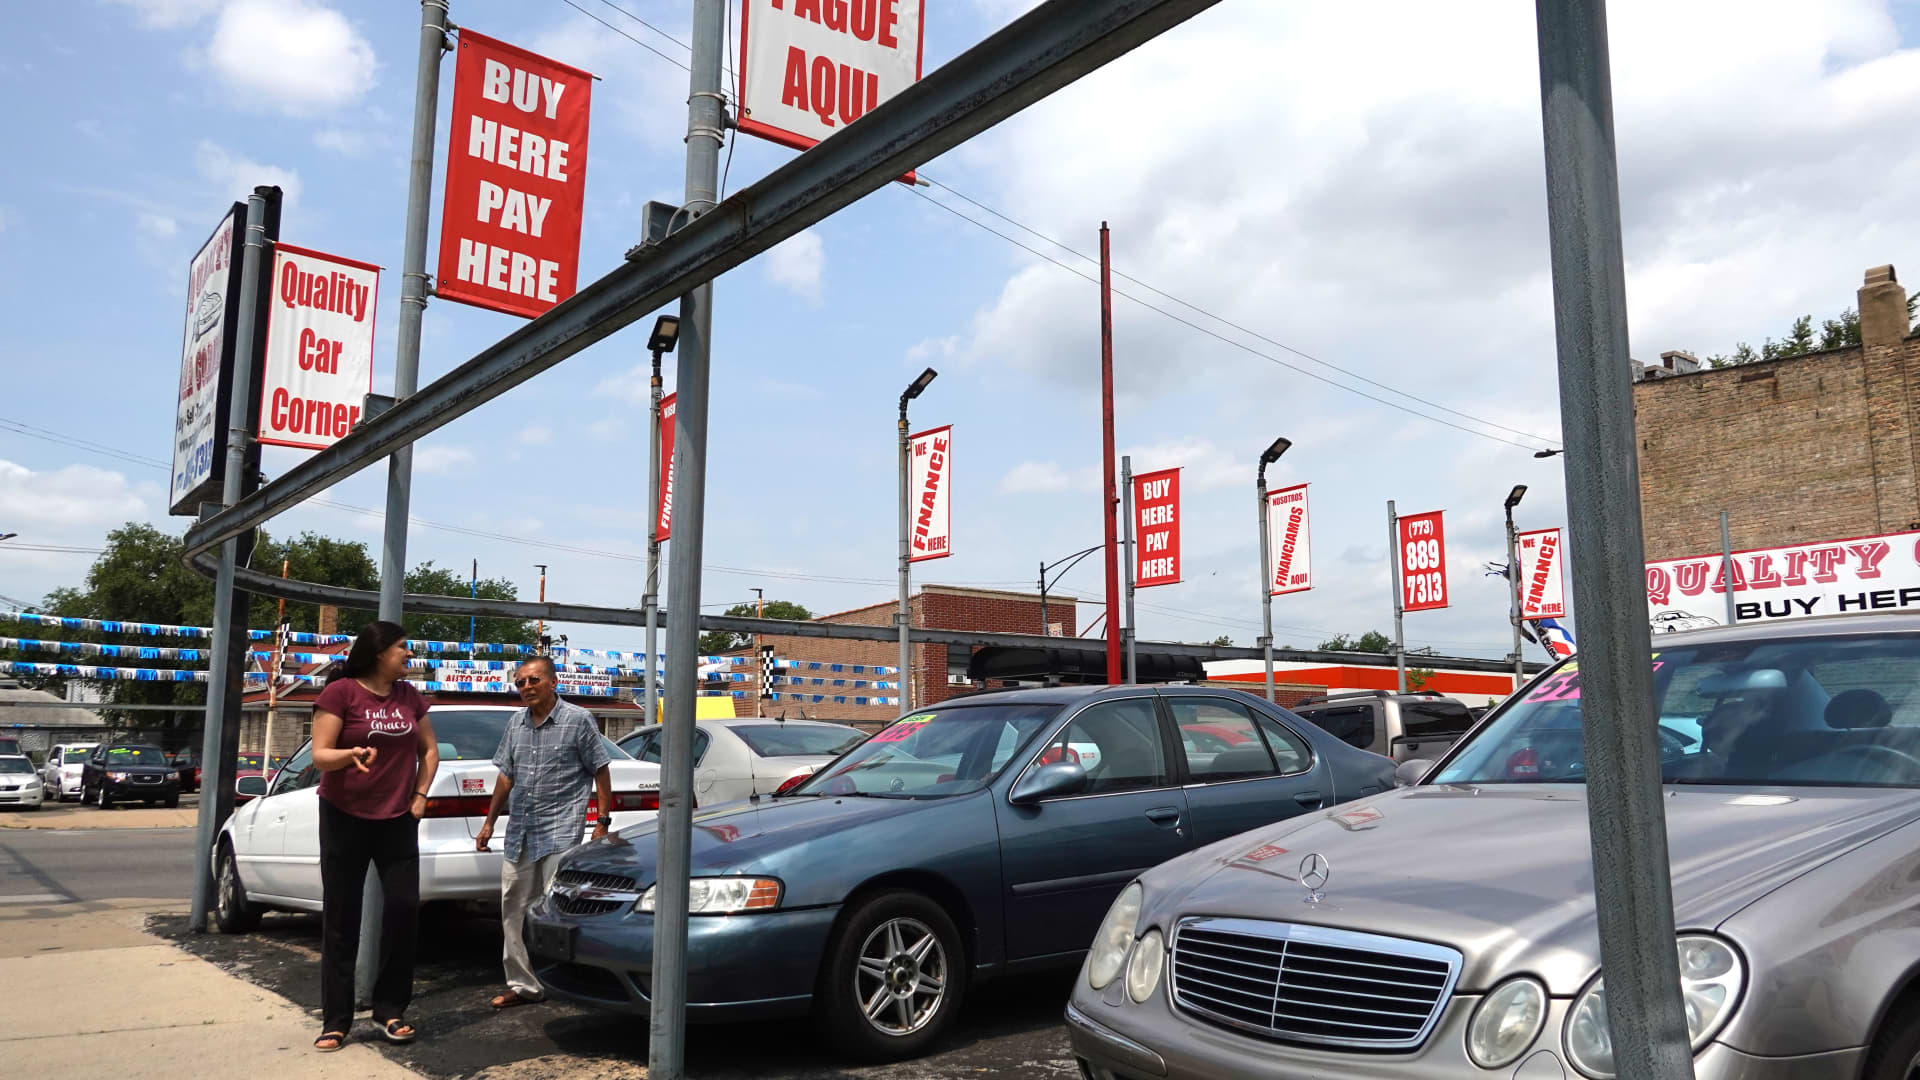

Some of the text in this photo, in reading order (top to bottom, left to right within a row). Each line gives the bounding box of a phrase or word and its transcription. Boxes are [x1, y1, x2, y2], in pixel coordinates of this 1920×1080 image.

[771, 0, 898, 49] GUE
[482, 58, 566, 120] BUY
[782, 45, 878, 127] AQUI
[468, 114, 569, 182] HERE
[477, 179, 552, 238] PAY
[457, 237, 560, 303] HERE
[281, 260, 369, 323] Quality
[299, 327, 343, 375] Car
[271, 387, 360, 438] Corner
[915, 442, 927, 456] WE
[913, 437, 947, 551] FINANCE
[1142, 478, 1171, 500] BUY
[1272, 492, 1303, 506] NOSOTROS
[1141, 504, 1174, 527] HERE
[1408, 519, 1434, 539] (773)
[927, 535, 946, 551] HERE
[1146, 531, 1170, 552] PAY
[1275, 506, 1303, 587] FINANCIAMOS
[1406, 539, 1440, 571] 889
[1522, 538, 1536, 549] WE
[1141, 557, 1174, 579] HERE
[1290, 573, 1308, 585] AQUI
[1525, 535, 1557, 613] FINANCE
[1646, 540, 1890, 606] QUALITY
[1406, 572, 1443, 604] 7313
[1541, 602, 1562, 614] HERE
[1736, 596, 1821, 620] BUY
[365, 708, 388, 719] Full
[370, 720, 408, 730] Grace
